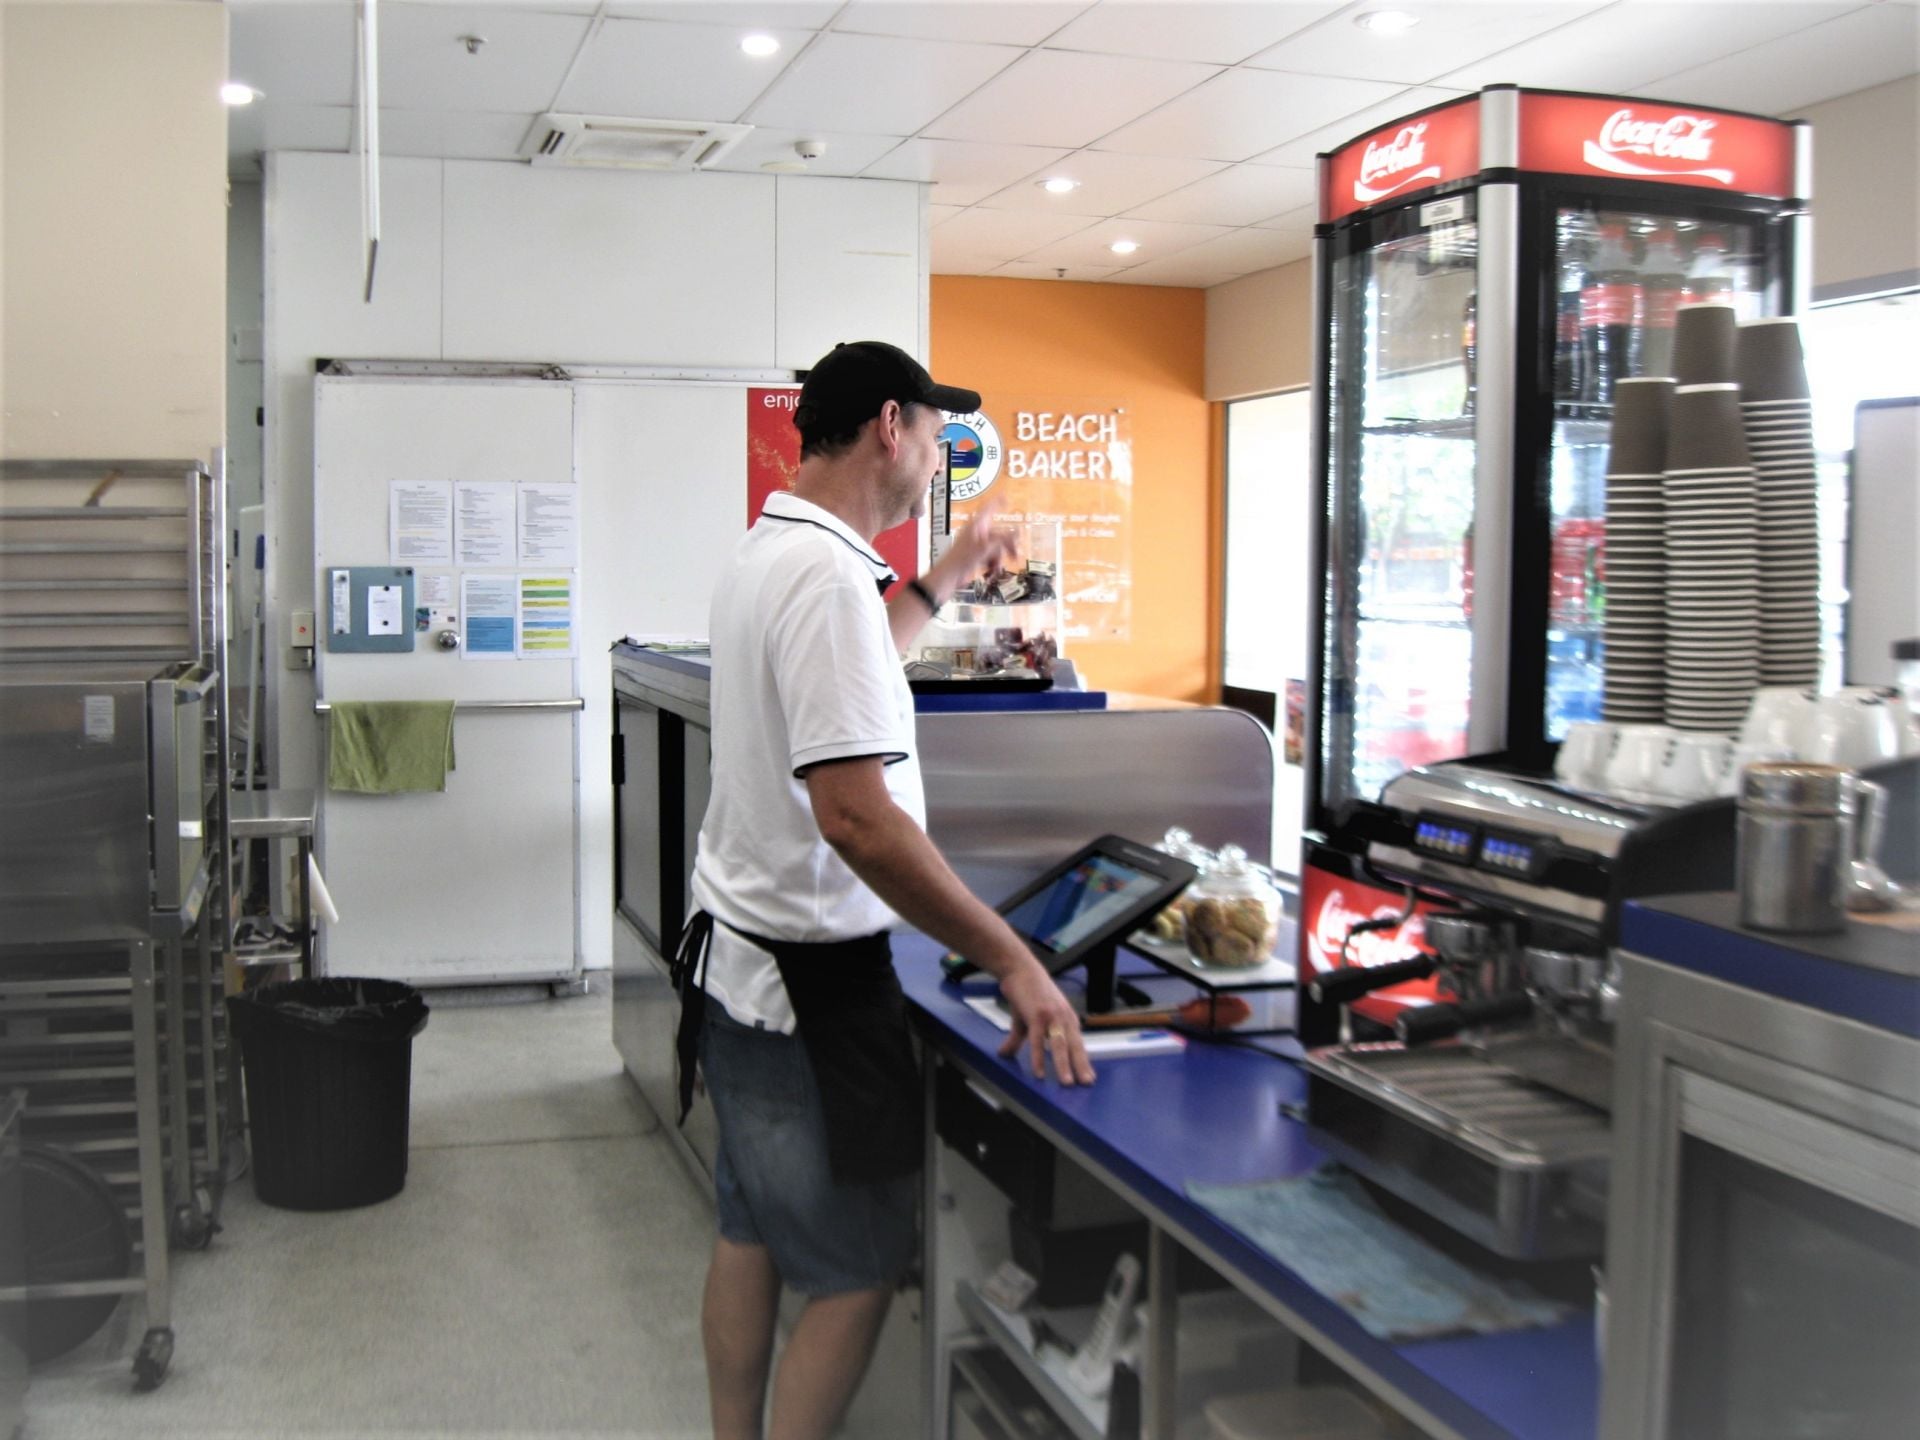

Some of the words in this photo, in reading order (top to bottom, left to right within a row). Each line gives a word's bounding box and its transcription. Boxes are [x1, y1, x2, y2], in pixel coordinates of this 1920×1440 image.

[763, 391, 801, 411] enj
[949, 411, 986, 431] ACH
[1017, 411, 1117, 443] BEACH
[950, 475, 983, 497] KERY
